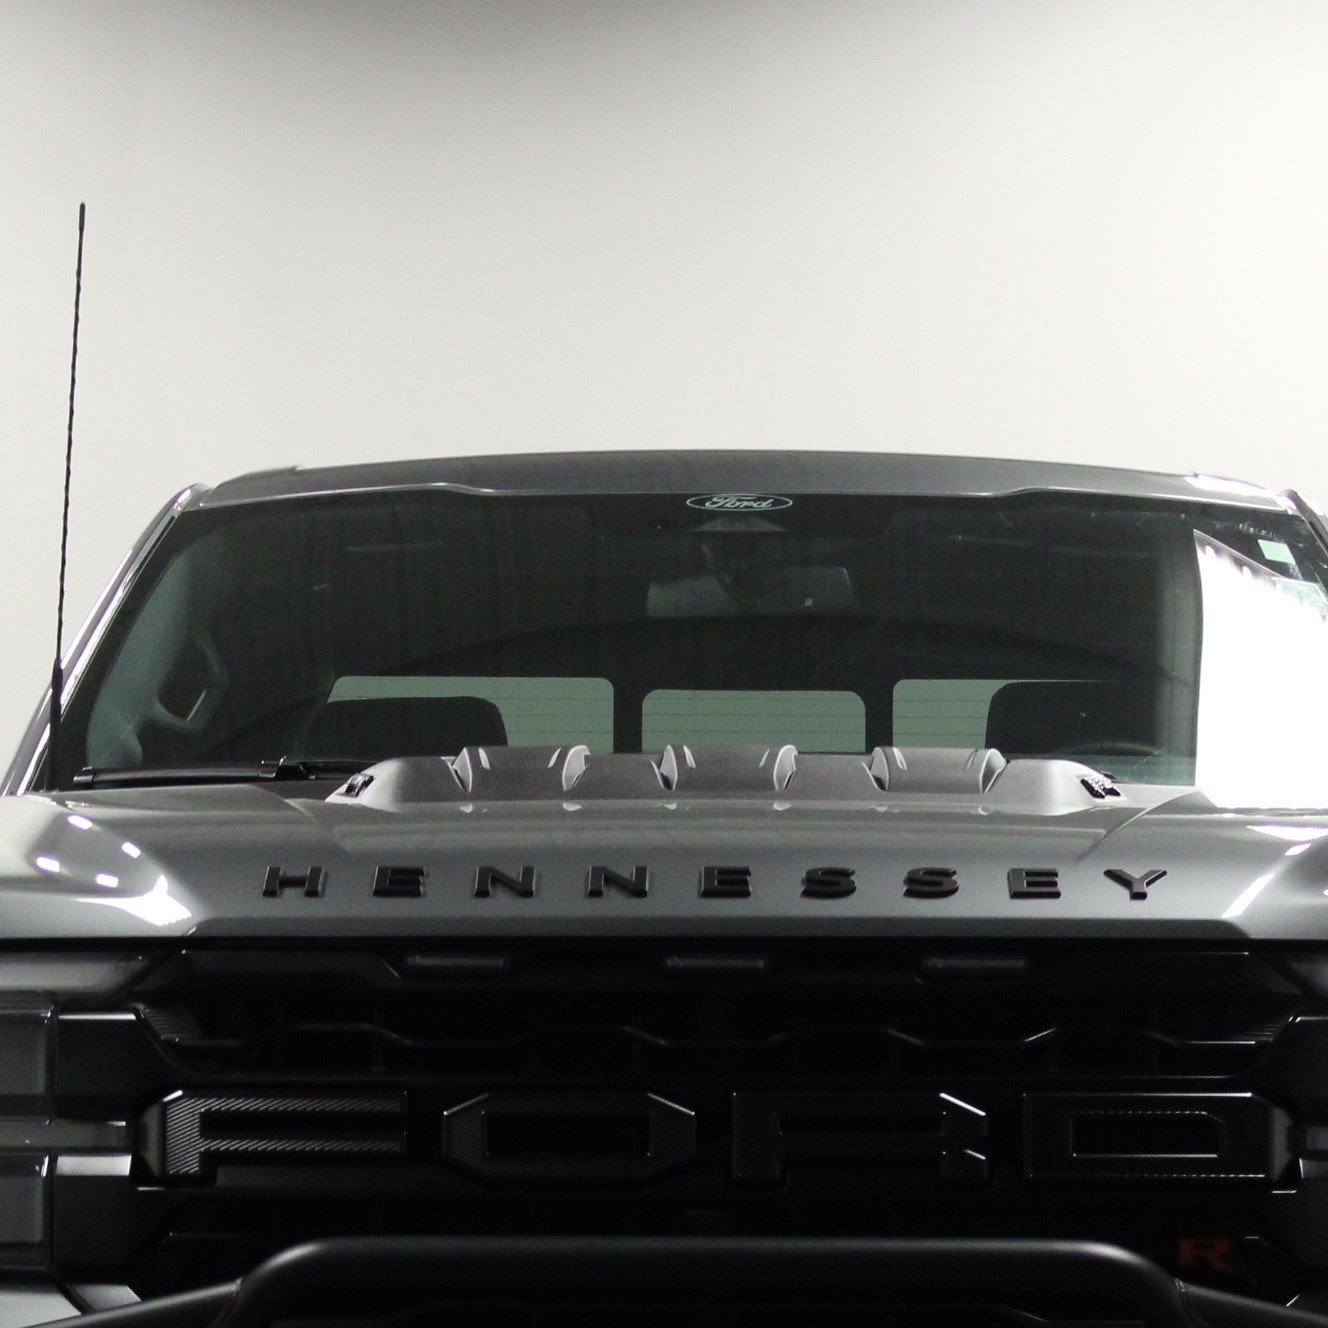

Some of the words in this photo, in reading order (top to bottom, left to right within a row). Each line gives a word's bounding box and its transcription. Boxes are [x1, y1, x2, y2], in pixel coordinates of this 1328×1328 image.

[705, 495, 774, 509] Ford
[262, 866, 1168, 900] HENNESSEY
[161, 1089, 1274, 1180] FORD
